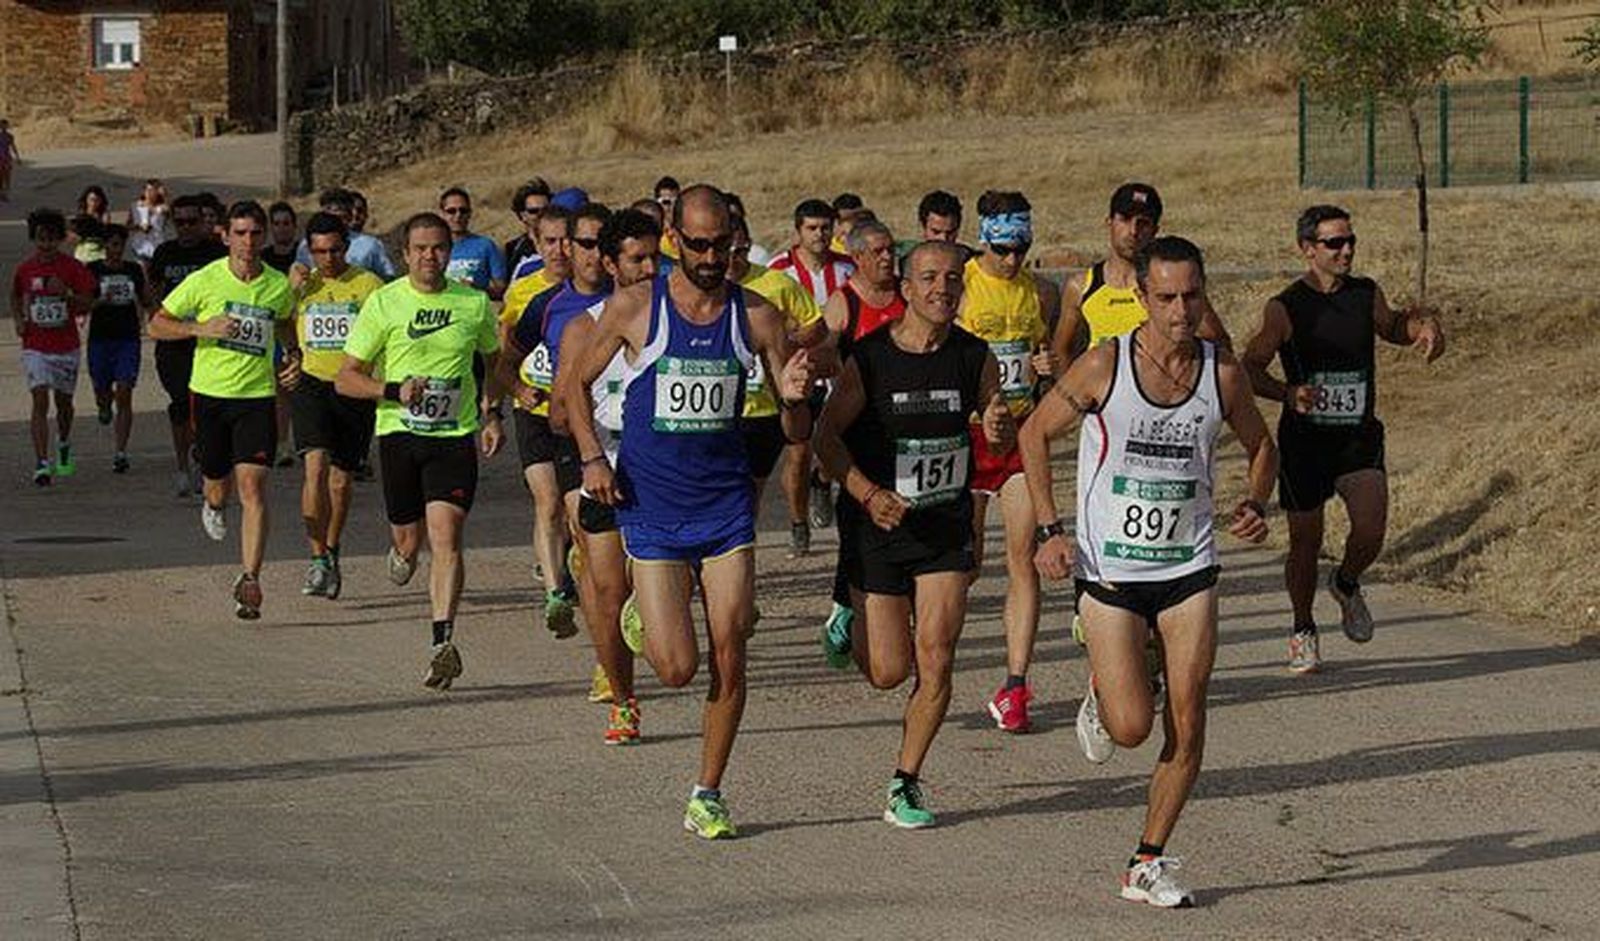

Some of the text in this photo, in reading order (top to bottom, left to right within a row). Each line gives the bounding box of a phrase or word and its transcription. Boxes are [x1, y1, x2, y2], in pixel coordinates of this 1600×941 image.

[312, 317, 349, 338] 896
[415, 309, 452, 325] RUN
[670, 382, 723, 413] 900
[1316, 386, 1357, 412] 843
[911, 455, 955, 489] 151
[1123, 504, 1180, 541] 897
